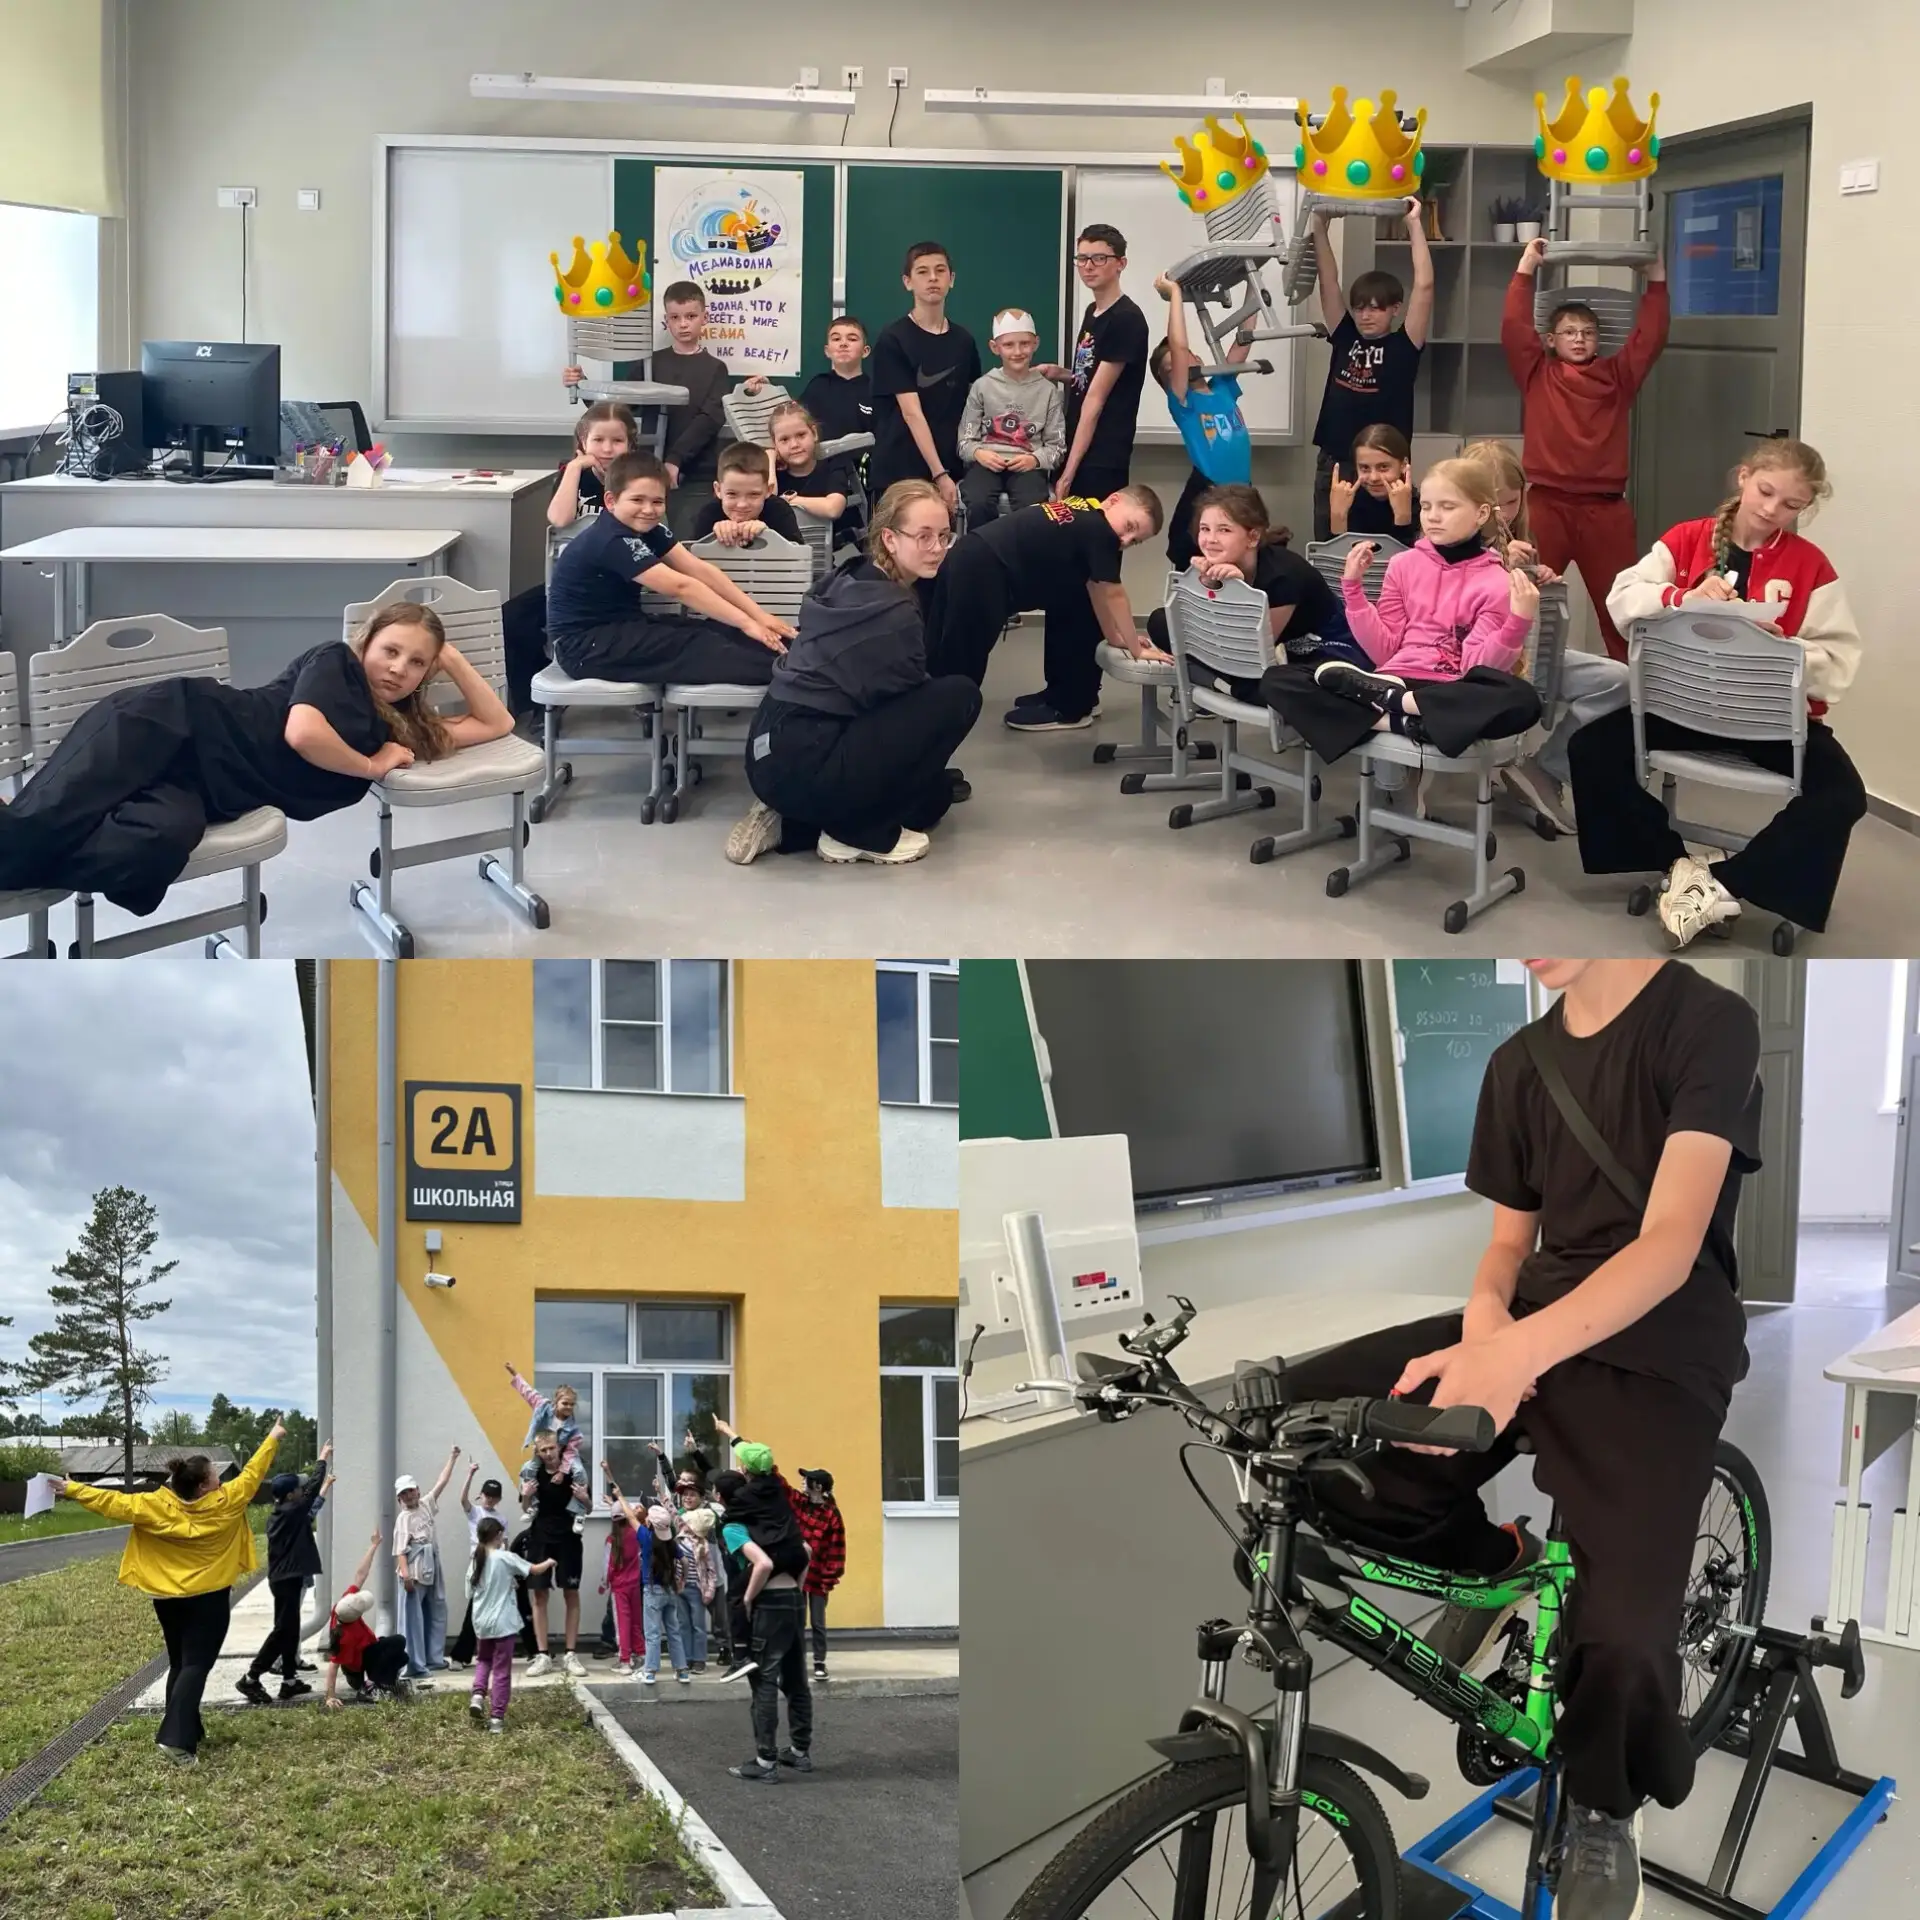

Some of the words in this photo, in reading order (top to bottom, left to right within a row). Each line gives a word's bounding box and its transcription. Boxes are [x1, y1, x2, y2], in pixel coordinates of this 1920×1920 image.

[689, 256, 773, 280] МЕДИАВОЛНА
[750, 300, 773, 312] ЧТО
[778, 302, 787, 313] К
[752, 316, 779, 328] МИРЕ
[699, 327, 746, 340] МЕДИА
[716, 347, 735, 357] НАС
[744, 347, 789, 363] ВЕДЁТ!
[431, 1105, 496, 1156] 2А
[413, 1187, 515, 1208] ШКОЛЬНАЯ
[1341, 1596, 1484, 1708] STELS
